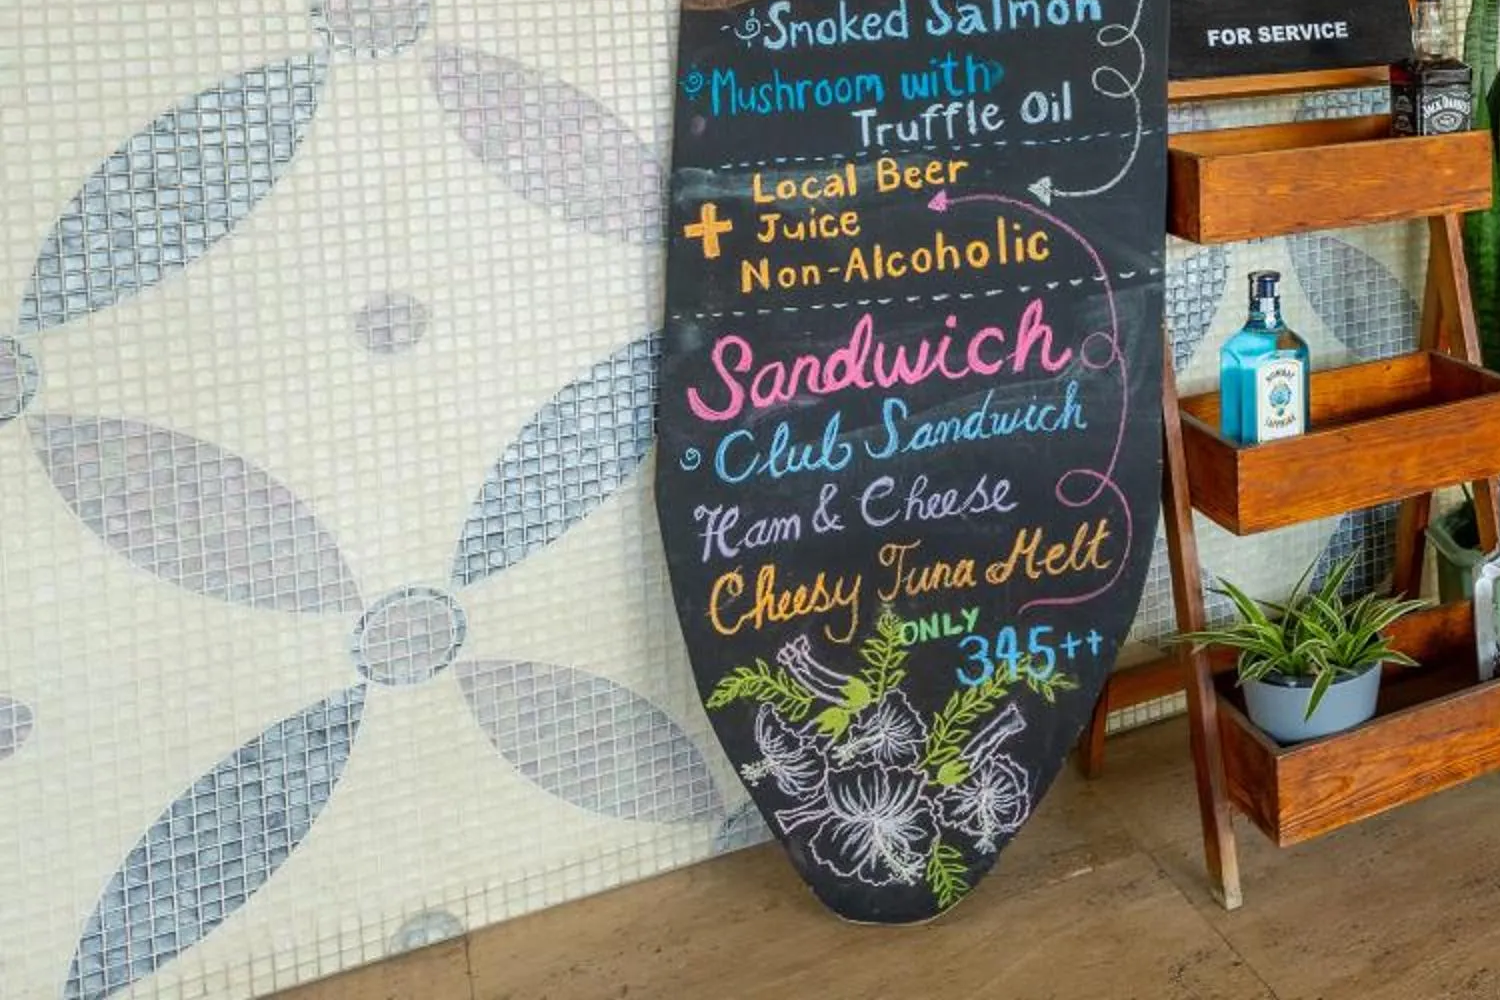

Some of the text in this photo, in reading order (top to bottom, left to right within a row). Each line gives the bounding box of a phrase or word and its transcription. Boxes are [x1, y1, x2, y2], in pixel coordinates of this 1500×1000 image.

[1207, 21, 1349, 47] FOR SERVICE
[710, 53, 996, 118] Mushroom with
[851, 80, 1073, 148] Truffle Oil
[753, 156, 970, 204] Local Beer
[741, 216, 1051, 294] Non-Alcoholic
[756, 207, 861, 245] Juice
[687, 298, 1073, 422] Sandwich
[714, 378, 1088, 484] Club Sandwich
[693, 474, 1020, 563] Ham & Cheese
[708, 518, 1114, 644] Cheesy Tuna Melt
[900, 605, 979, 647] ONLY
